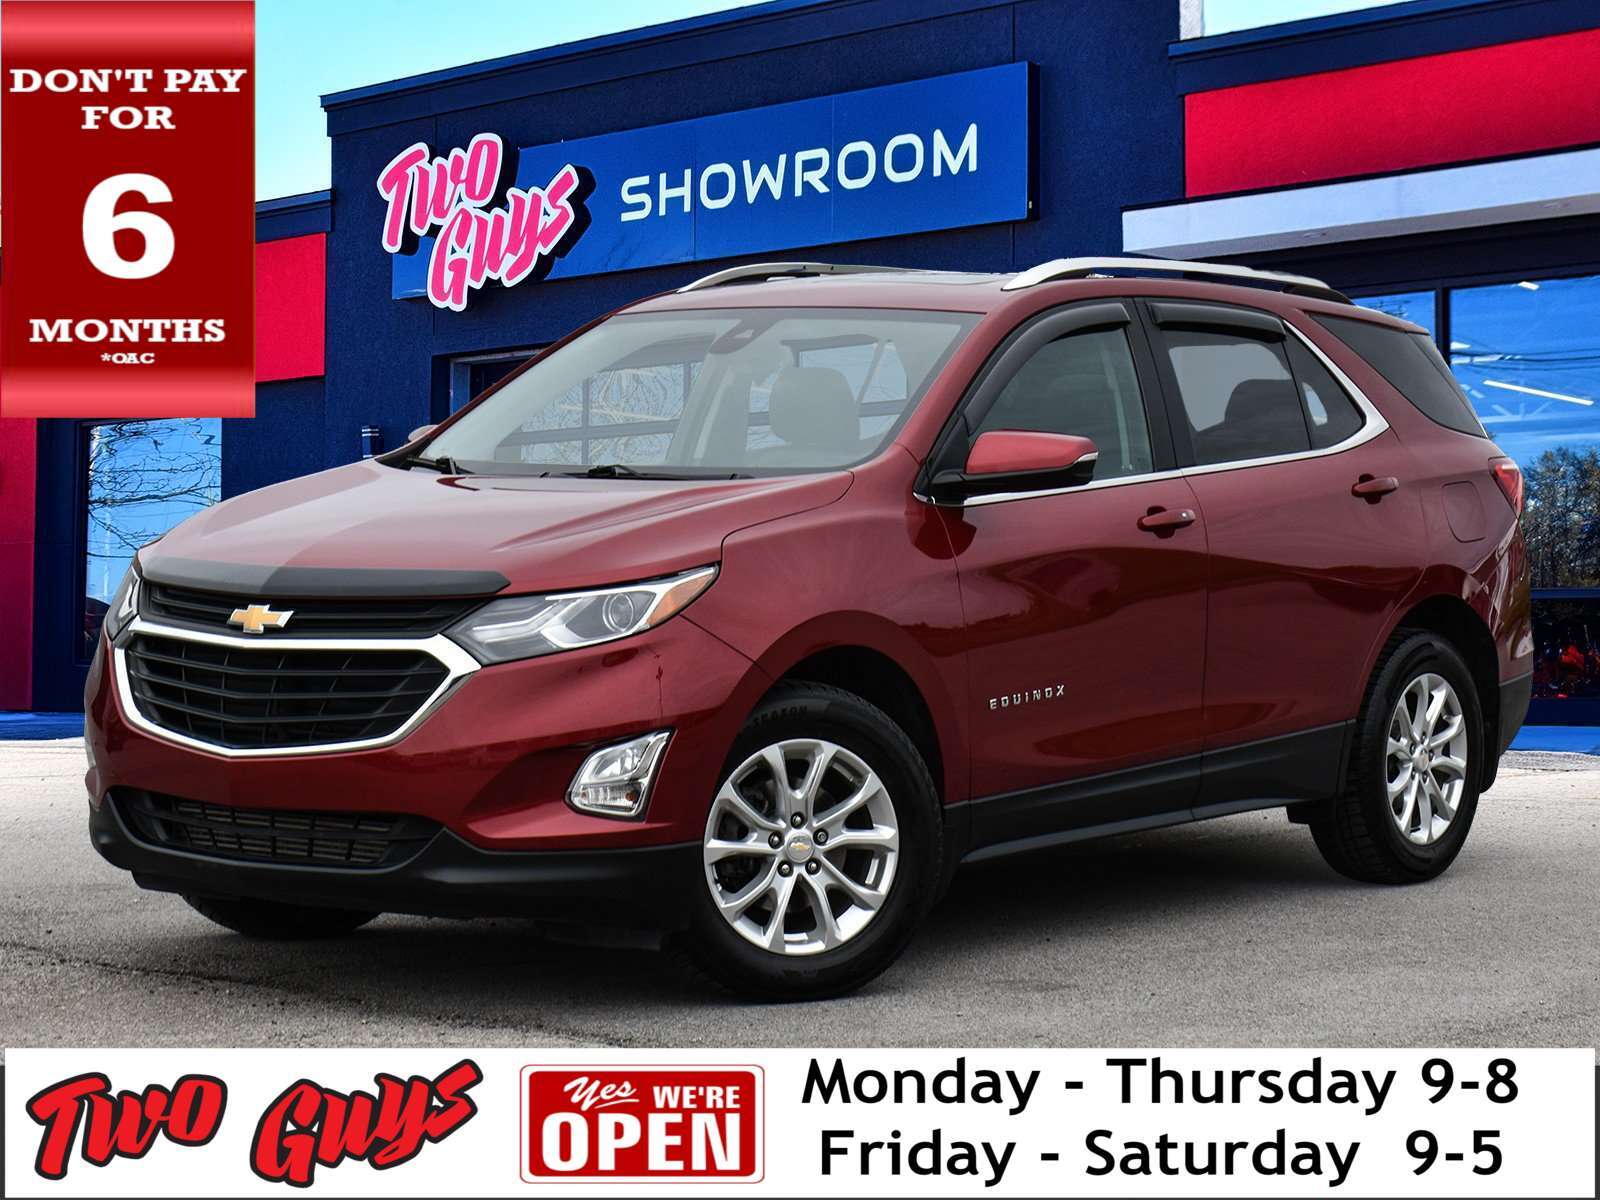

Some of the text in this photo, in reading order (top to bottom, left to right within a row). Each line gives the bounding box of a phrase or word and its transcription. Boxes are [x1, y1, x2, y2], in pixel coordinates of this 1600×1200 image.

[378, 133, 503, 253] Two
[620, 122, 978, 222] SHOWROOM
[427, 164, 579, 312] Guys
[989, 684, 1065, 710] EQUINOX
